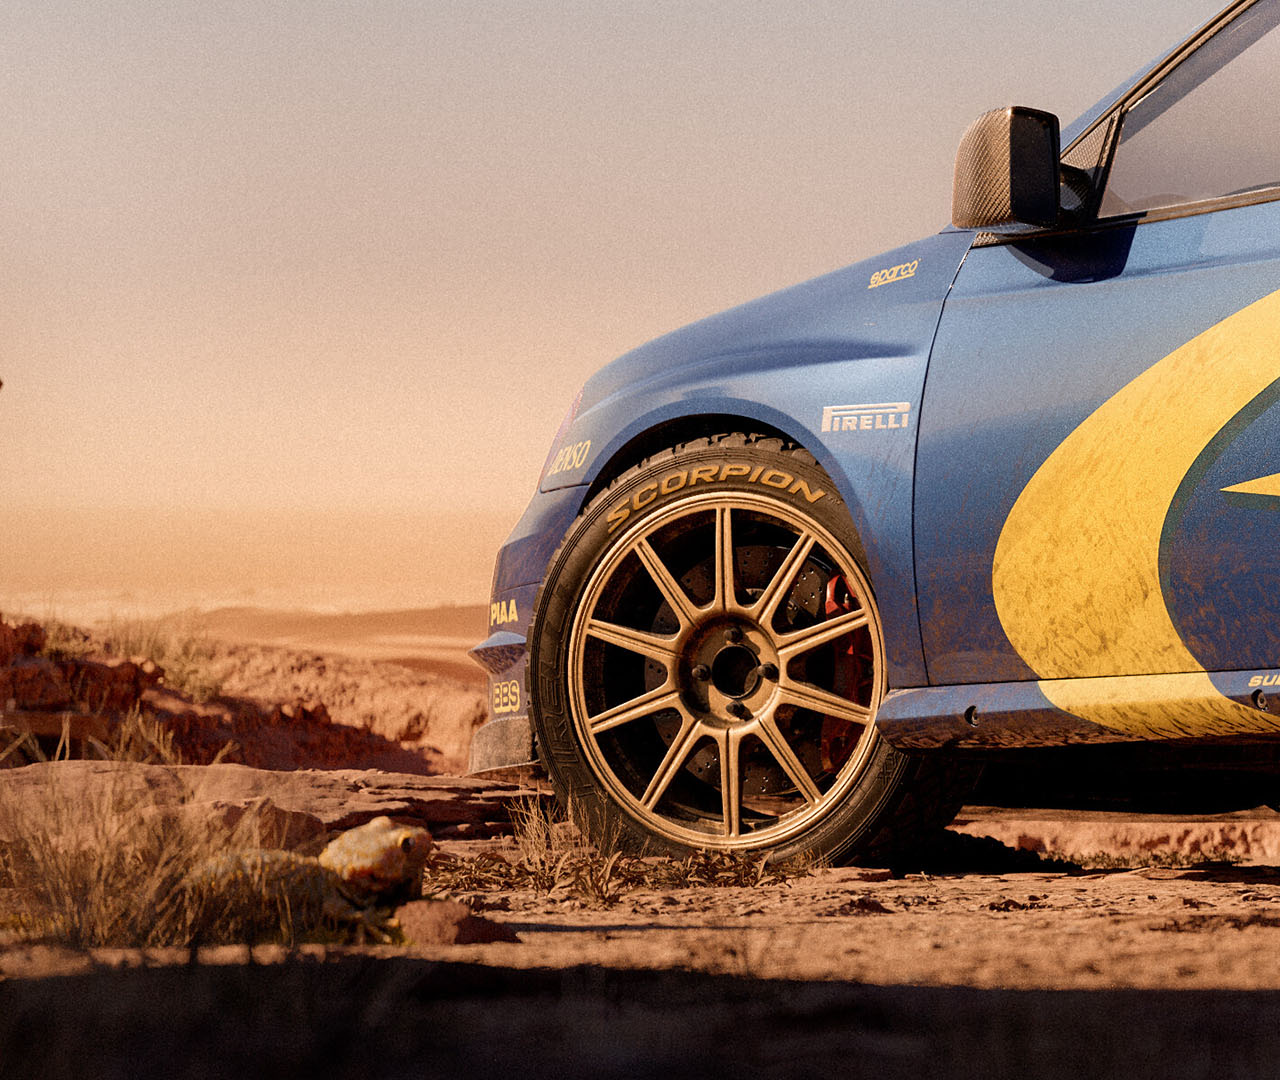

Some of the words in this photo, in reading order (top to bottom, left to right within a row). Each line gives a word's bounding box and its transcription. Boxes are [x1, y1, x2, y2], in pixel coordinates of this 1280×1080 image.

[868, 258, 921, 289] sparco
[821, 401, 911, 433] PIRELLI
[607, 464, 827, 534] SCORPION
[490, 599, 519, 627] PIAA
[493, 680, 520, 714] BBS
